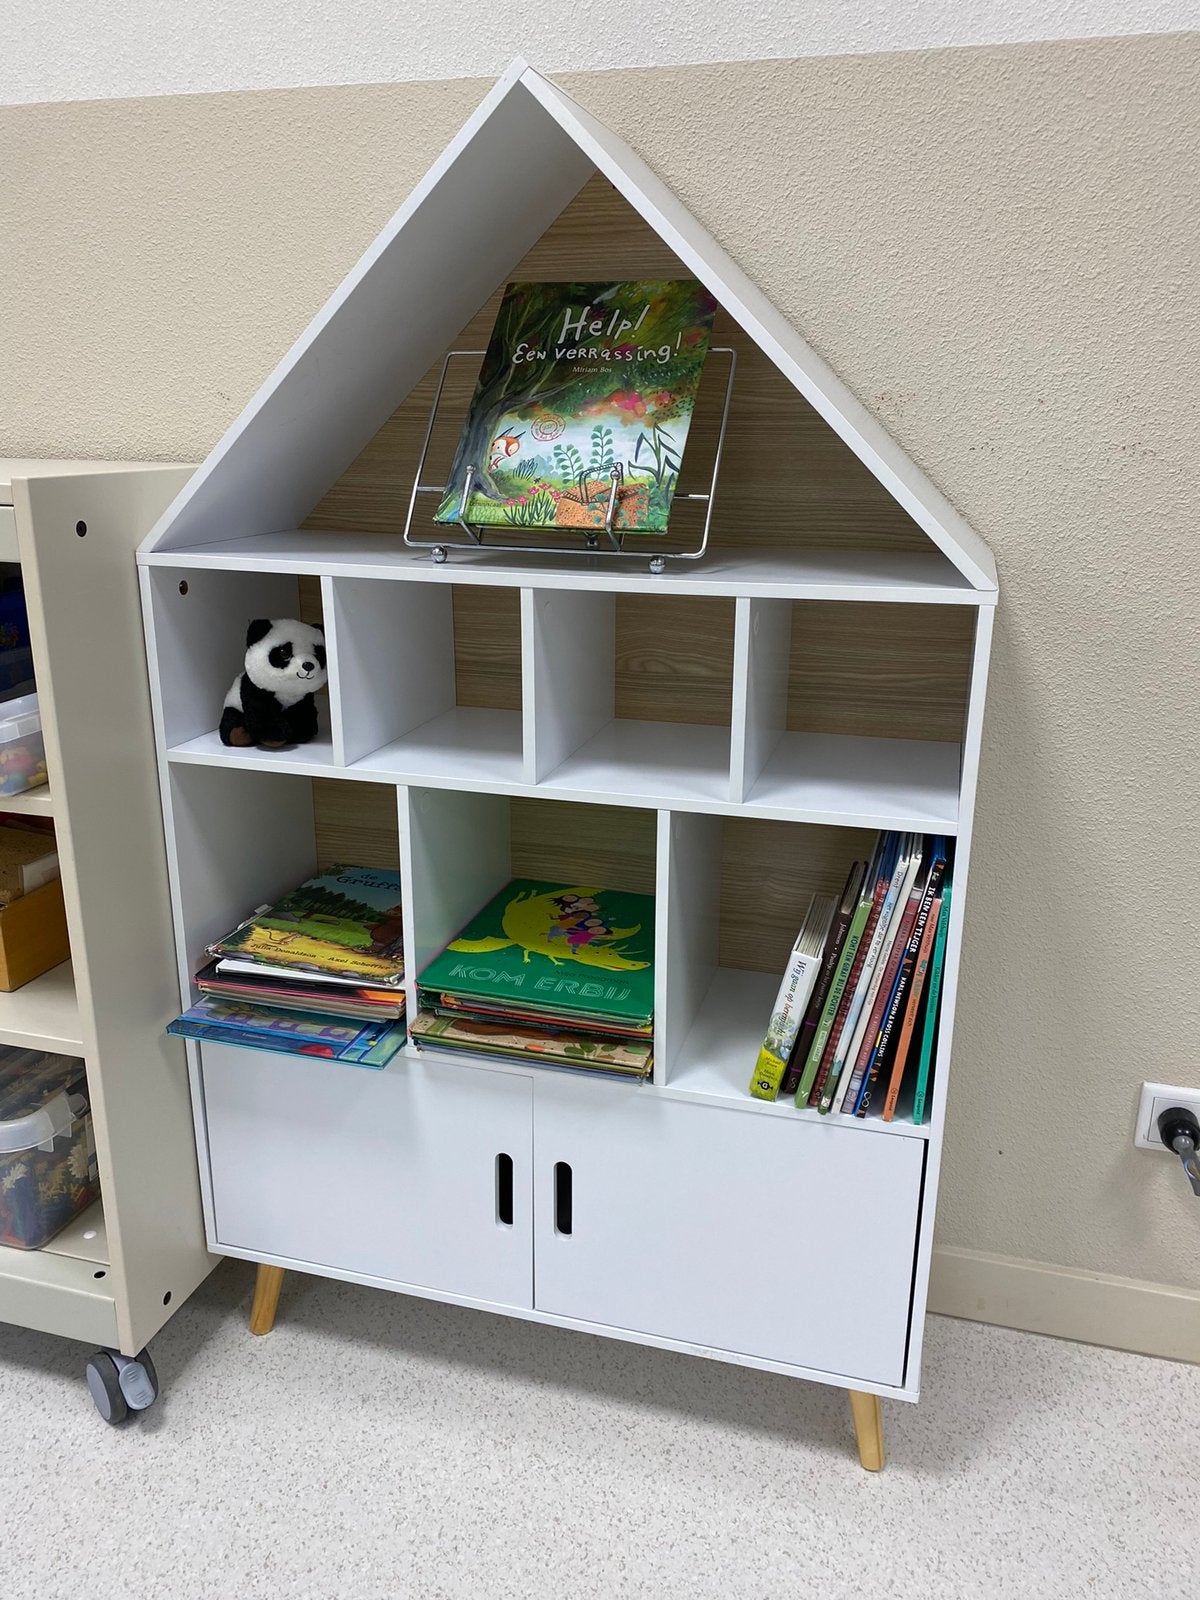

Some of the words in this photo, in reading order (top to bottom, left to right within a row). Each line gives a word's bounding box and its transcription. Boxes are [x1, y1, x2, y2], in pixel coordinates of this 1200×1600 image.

[557, 304, 650, 344] Help!
[926, 886, 935, 897] IK
[921, 896, 932, 911] BEN
[916, 911, 927, 927] EEN
[832, 922, 847, 945] Johnson
[908, 926, 923, 954] TIJGER
[847, 934, 859, 951] KOMT
[275, 948, 317, 958] Donaldson
[328, 956, 348, 964] Axel
[844, 951, 854, 962] EEN
[791, 959, 807, 976] Wij
[839, 961, 850, 978] GIRAF
[449, 964, 526, 987] KOM
[534, 976, 632, 1001] ERBIJ
[786, 973, 800, 993] gaan
[833, 986, 842, 995] DE
[835, 977, 845, 987] BIJ
[897, 976, 906, 992] KARL
[783, 992, 794, 1002] op
[826, 994, 840, 1017] DOKTER
[889, 991, 901, 1015] NEWSON
[884, 1019, 893, 1034] ROSS
[876, 1033, 889, 1058] COLLINS
